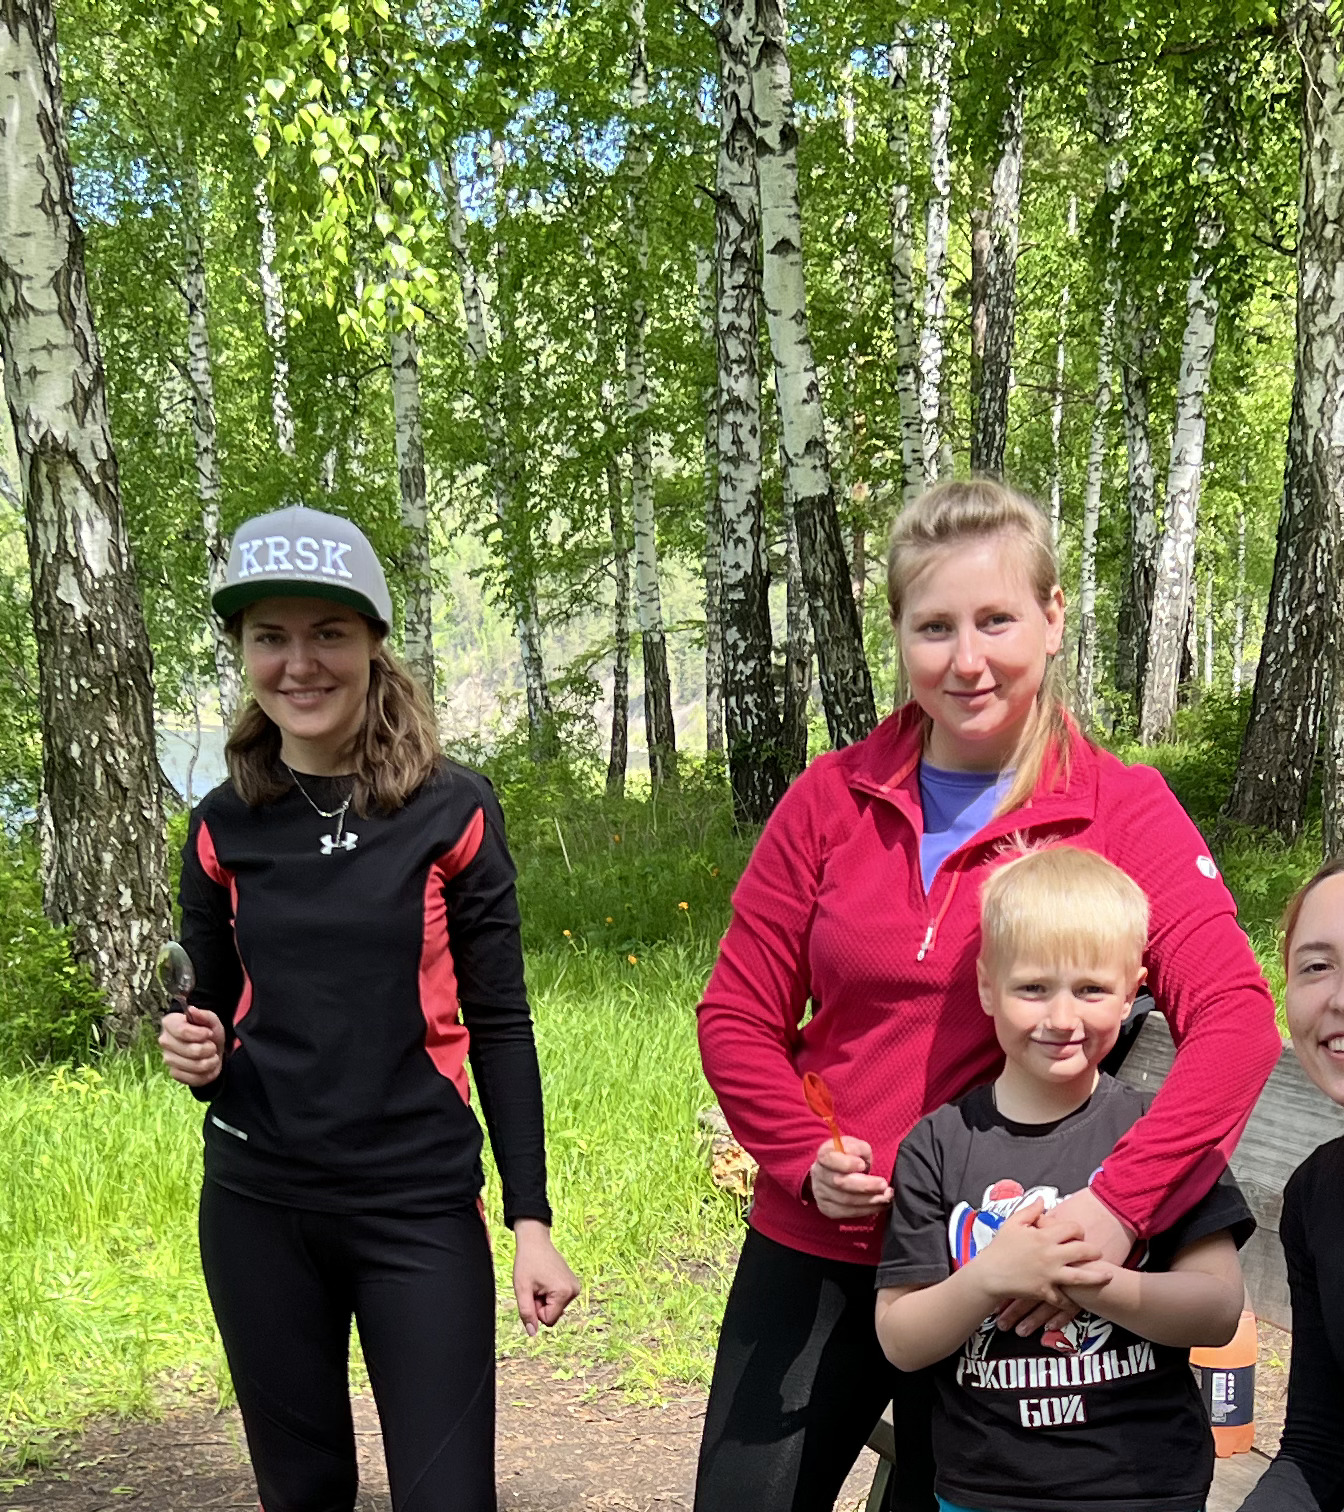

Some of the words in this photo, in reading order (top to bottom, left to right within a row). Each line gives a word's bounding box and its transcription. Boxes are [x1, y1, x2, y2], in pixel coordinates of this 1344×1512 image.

[238, 535, 353, 579] KRSK
[955, 1341, 1156, 1390] РУКОПАШНЫЙ
[1018, 1394, 1087, 1428] БОЙ
